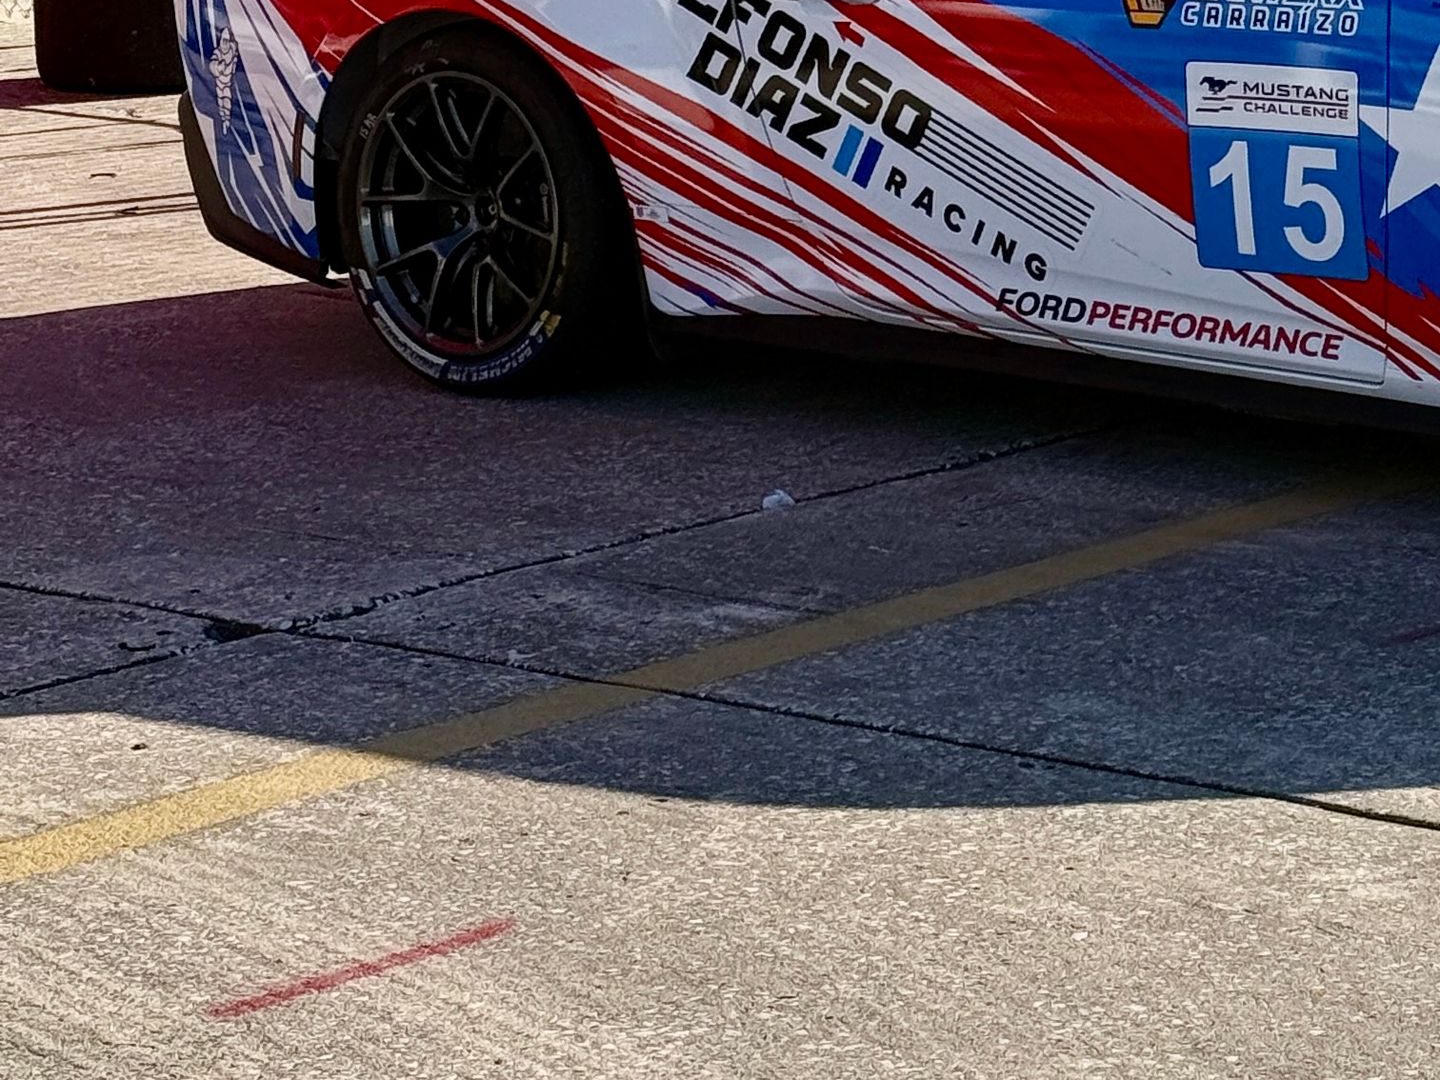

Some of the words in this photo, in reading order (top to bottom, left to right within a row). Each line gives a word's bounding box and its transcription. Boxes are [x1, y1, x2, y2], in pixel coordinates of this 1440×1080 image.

[686, 31, 842, 160] DIAZ
[1242, 81, 1349, 102] MUSTANG
[1243, 102, 1349, 120] CHALLENGE
[885, 166, 1048, 282] RACING
[1208, 140, 1345, 262] 15
